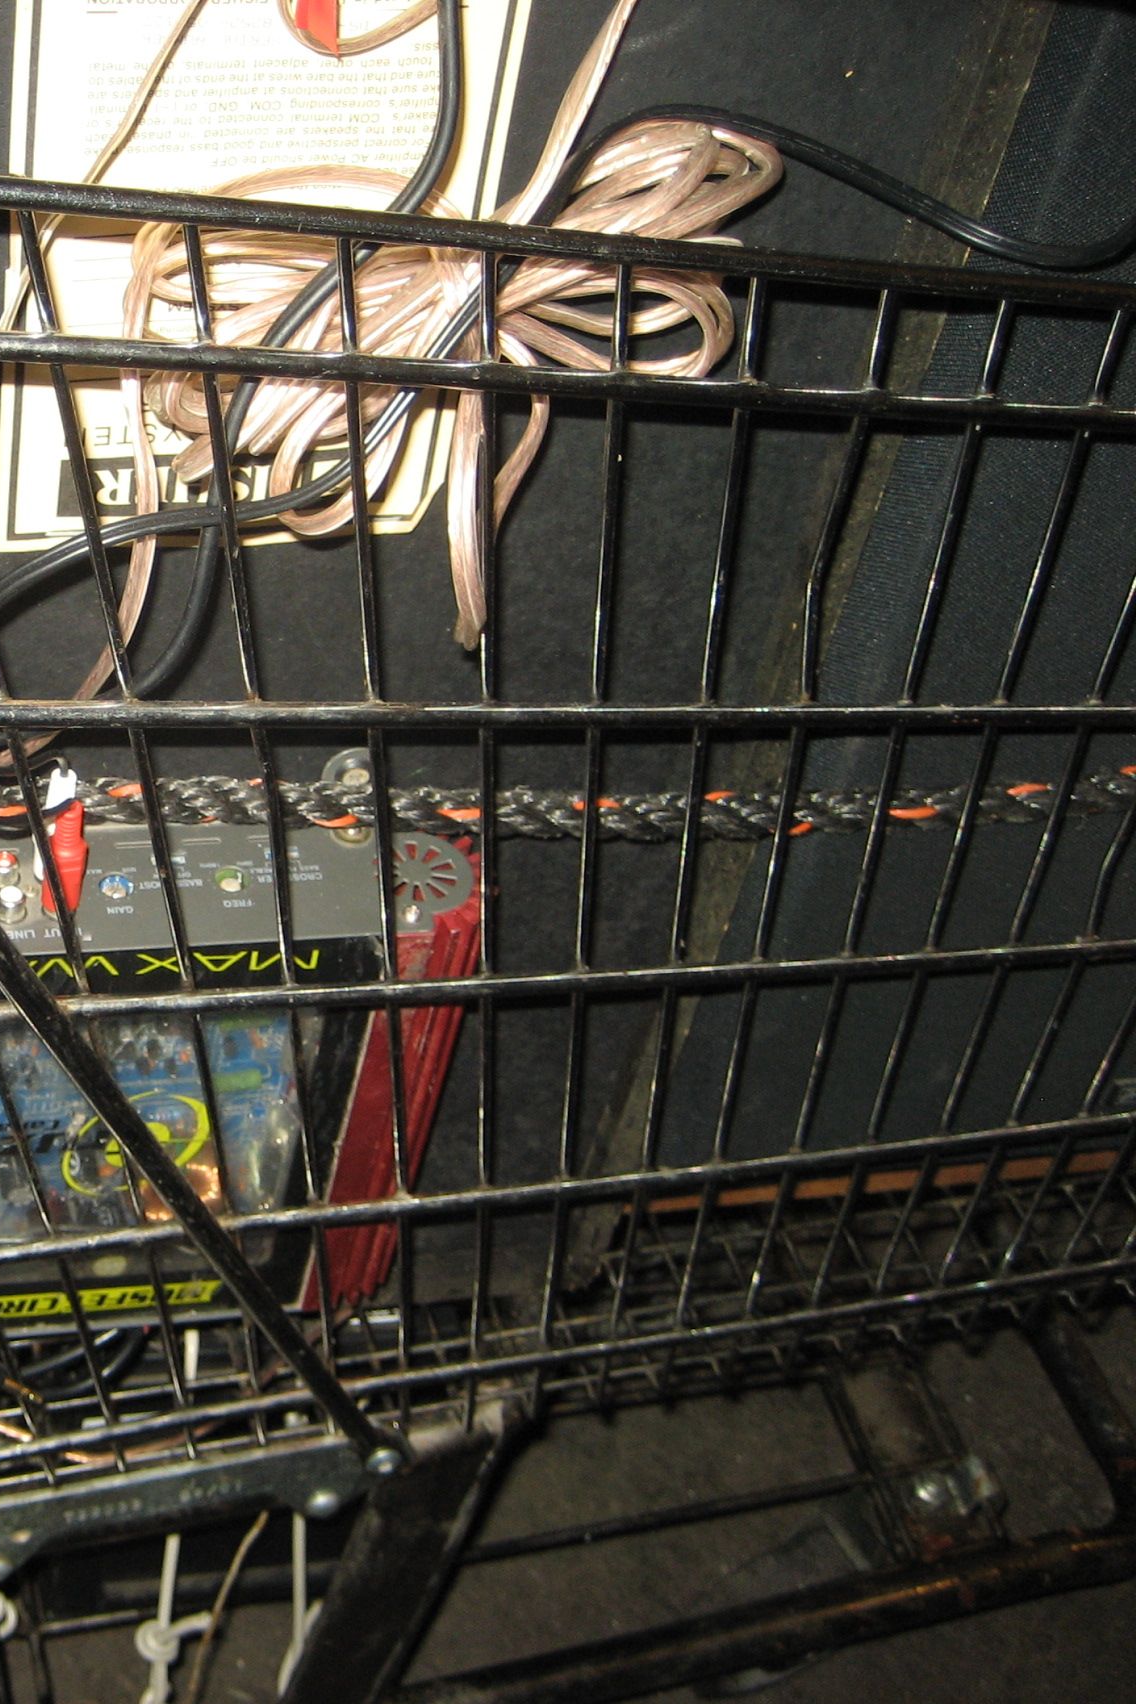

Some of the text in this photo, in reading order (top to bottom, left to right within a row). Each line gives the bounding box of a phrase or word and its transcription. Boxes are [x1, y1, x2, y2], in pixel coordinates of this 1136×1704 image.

[253, 57, 310, 69] adjacent
[360, 58, 391, 68] each
[397, 56, 433, 67] touch
[88, 62, 126, 73] metal
[87, 76, 105, 87] do
[178, 75, 192, 85] of
[194, 74, 226, 85] ends
[228, 73, 249, 84] the
[252, 72, 265, 83] at
[268, 72, 303, 84] wires
[305, 73, 335, 83] bare
[337, 72, 359, 83] the
[361, 72, 387, 83] that
[390, 70, 414, 82] and
[174, 89, 199, 99] and
[202, 86, 259, 99] amplifier
[263, 86, 276, 96] at
[280, 86, 359, 96] connections
[362, 85, 388, 97] that
[391, 85, 418, 95] sure
[87, 91, 108, 101] are
[289, 97, 381, 110] corresponding
[199, 115, 212, 126] to
[217, 113, 284, 125] connected
[290, 113, 343, 124] terminal
[203, 127, 270, 139] connected
[275, 127, 296, 136] are
[302, 124, 360, 137] speakers
[365, 126, 385, 136] the
[391, 125, 417, 136] that
[189, 142, 220, 153] bass
[222, 139, 256, 151] good
[259, 139, 283, 149] and
[286, 137, 360, 150] perspective
[363, 138, 408, 150] correct
[241, 155, 258, 165] be
[261, 154, 305, 165] should
[307, 153, 347, 164] Power
[351, 152, 370, 164] AC
[222, 899, 252, 908] FREQ
[106, 905, 134, 915] GAIN
[135, 949, 320, 975] MAX
[69, 1286, 208, 1310] MOSFE
